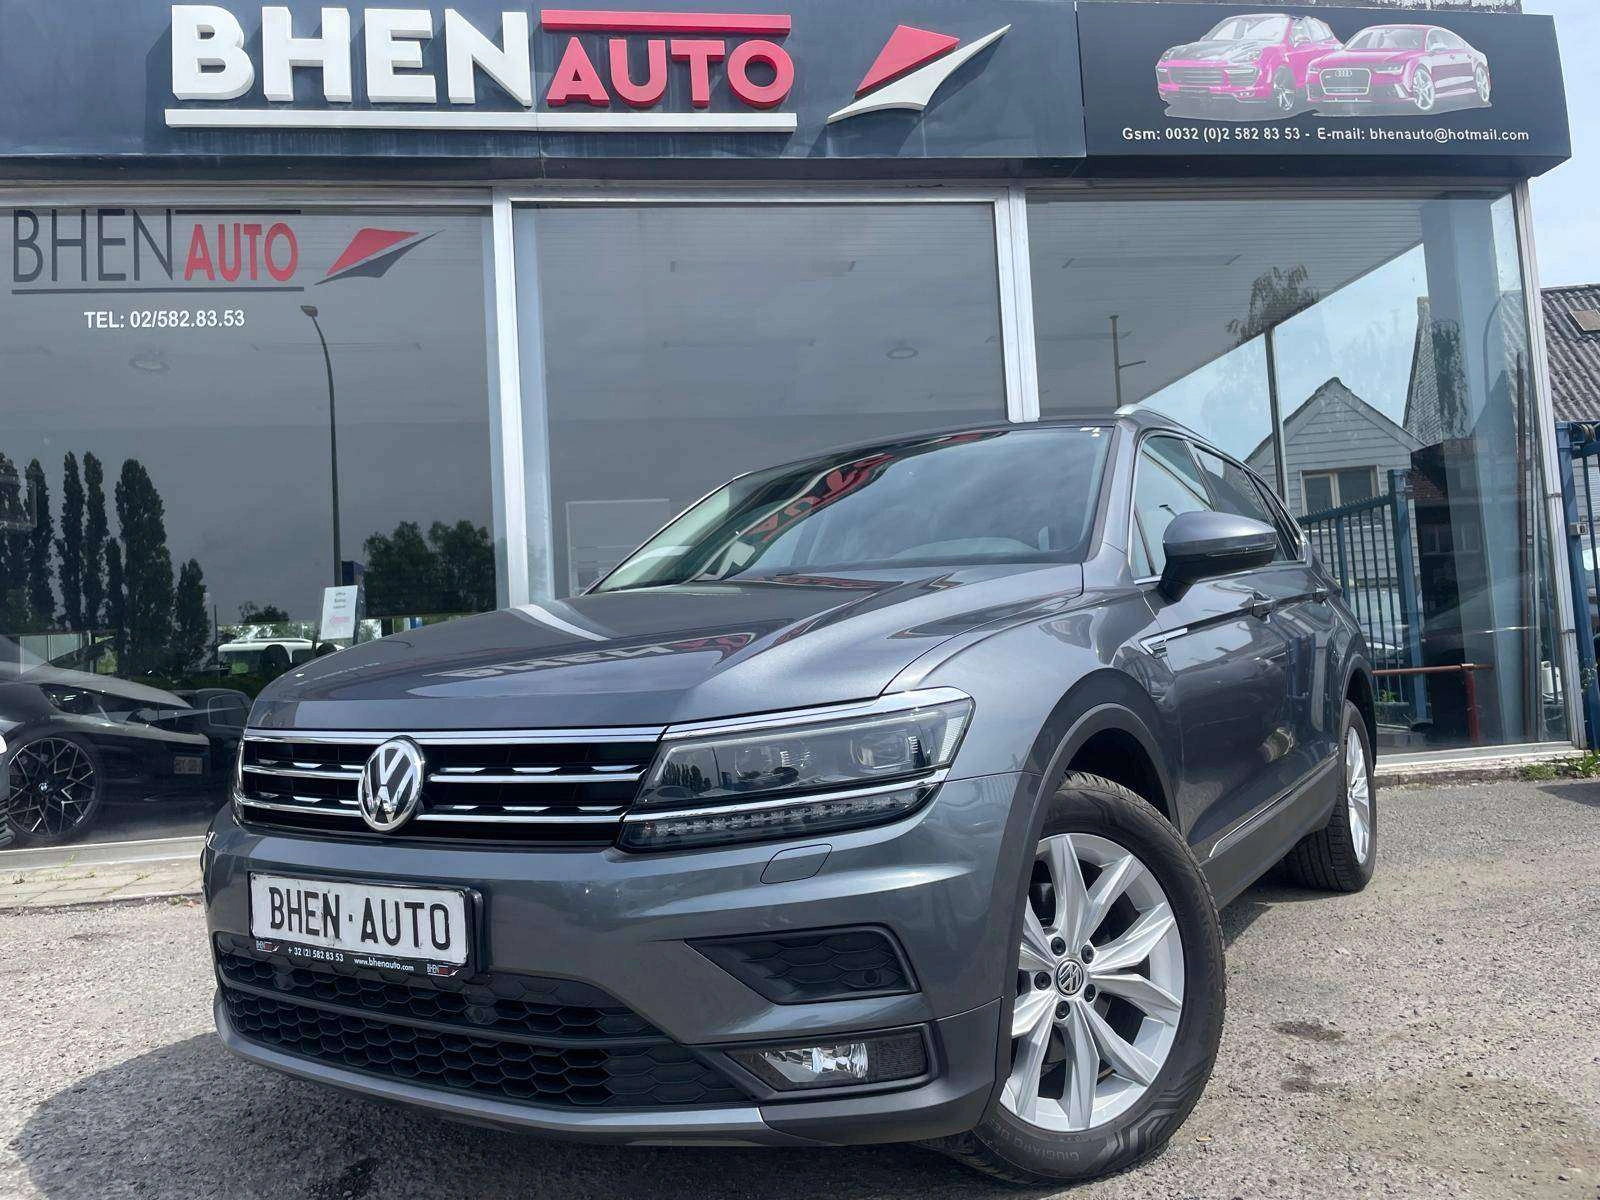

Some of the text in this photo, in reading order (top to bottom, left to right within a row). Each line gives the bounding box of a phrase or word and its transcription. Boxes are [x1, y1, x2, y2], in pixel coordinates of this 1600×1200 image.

[171, 5, 797, 109] BHEN AUTO
[1122, 127, 1161, 141] Gsm:
[1165, 127, 1199, 140] 0032
[1203, 127, 1230, 143] (0)2
[1234, 127, 1259, 140] 582
[1263, 127, 1280, 140] 83
[1284, 127, 1301, 140] 53
[1317, 127, 1365, 141] E-mail:
[1369, 127, 1530, 144] bhenauto@hotmail.com
[13, 209, 299, 282] BHEN AUTO
[84, 309, 246, 328] TEL: 02/582.83.53
[268, 886, 341, 939] BHEN
[360, 897, 451, 950] AUTO
[293, 947, 302, 956] 32
[312, 949, 325, 960] 582
[325, 951, 334, 961] 83
[334, 952, 344, 962] 53
[353, 957, 414, 973] www.bhenauto.com
